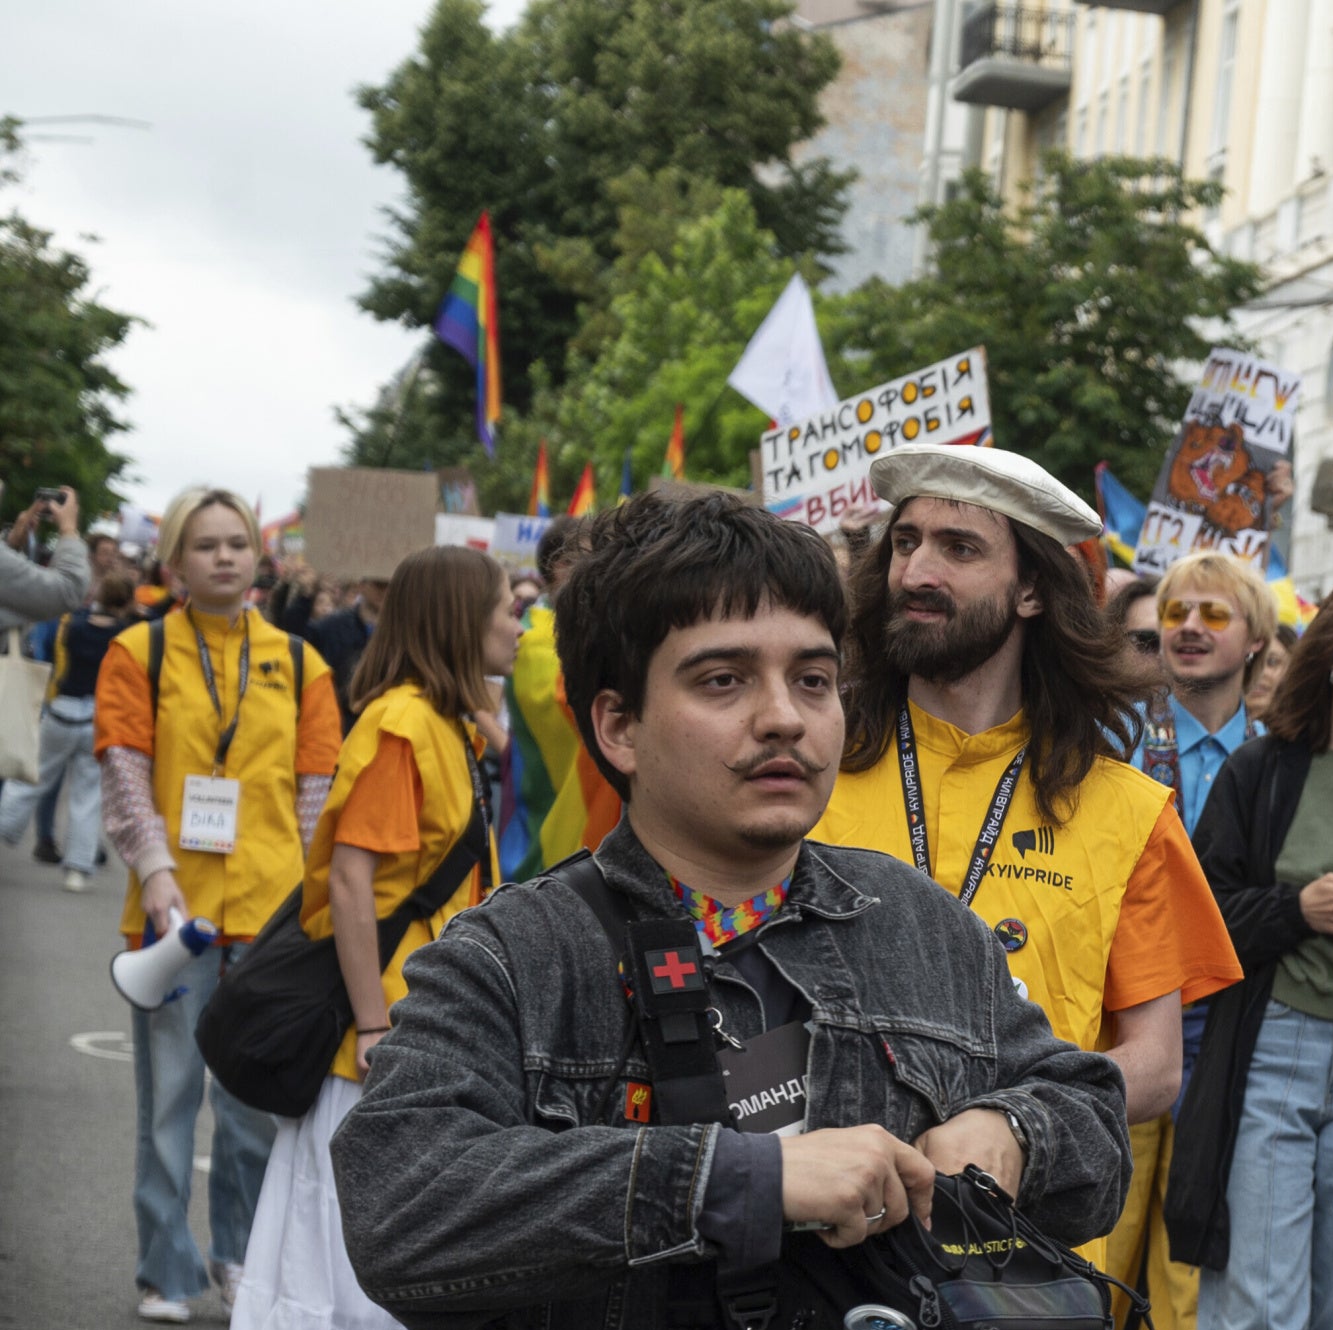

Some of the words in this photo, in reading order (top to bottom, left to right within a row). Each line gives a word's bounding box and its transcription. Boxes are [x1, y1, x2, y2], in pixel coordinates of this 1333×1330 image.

[764, 356, 974, 461] ТРАНСОФОБІЯ
[767, 464, 803, 493] ТА
[809, 396, 975, 477] ГОМОФОБІЯ
[901, 751, 920, 812] KYIVPRIDE
[979, 775, 1013, 846] КИЇВПРАЙД
[983, 862, 1073, 891] KYIVPRIDE
